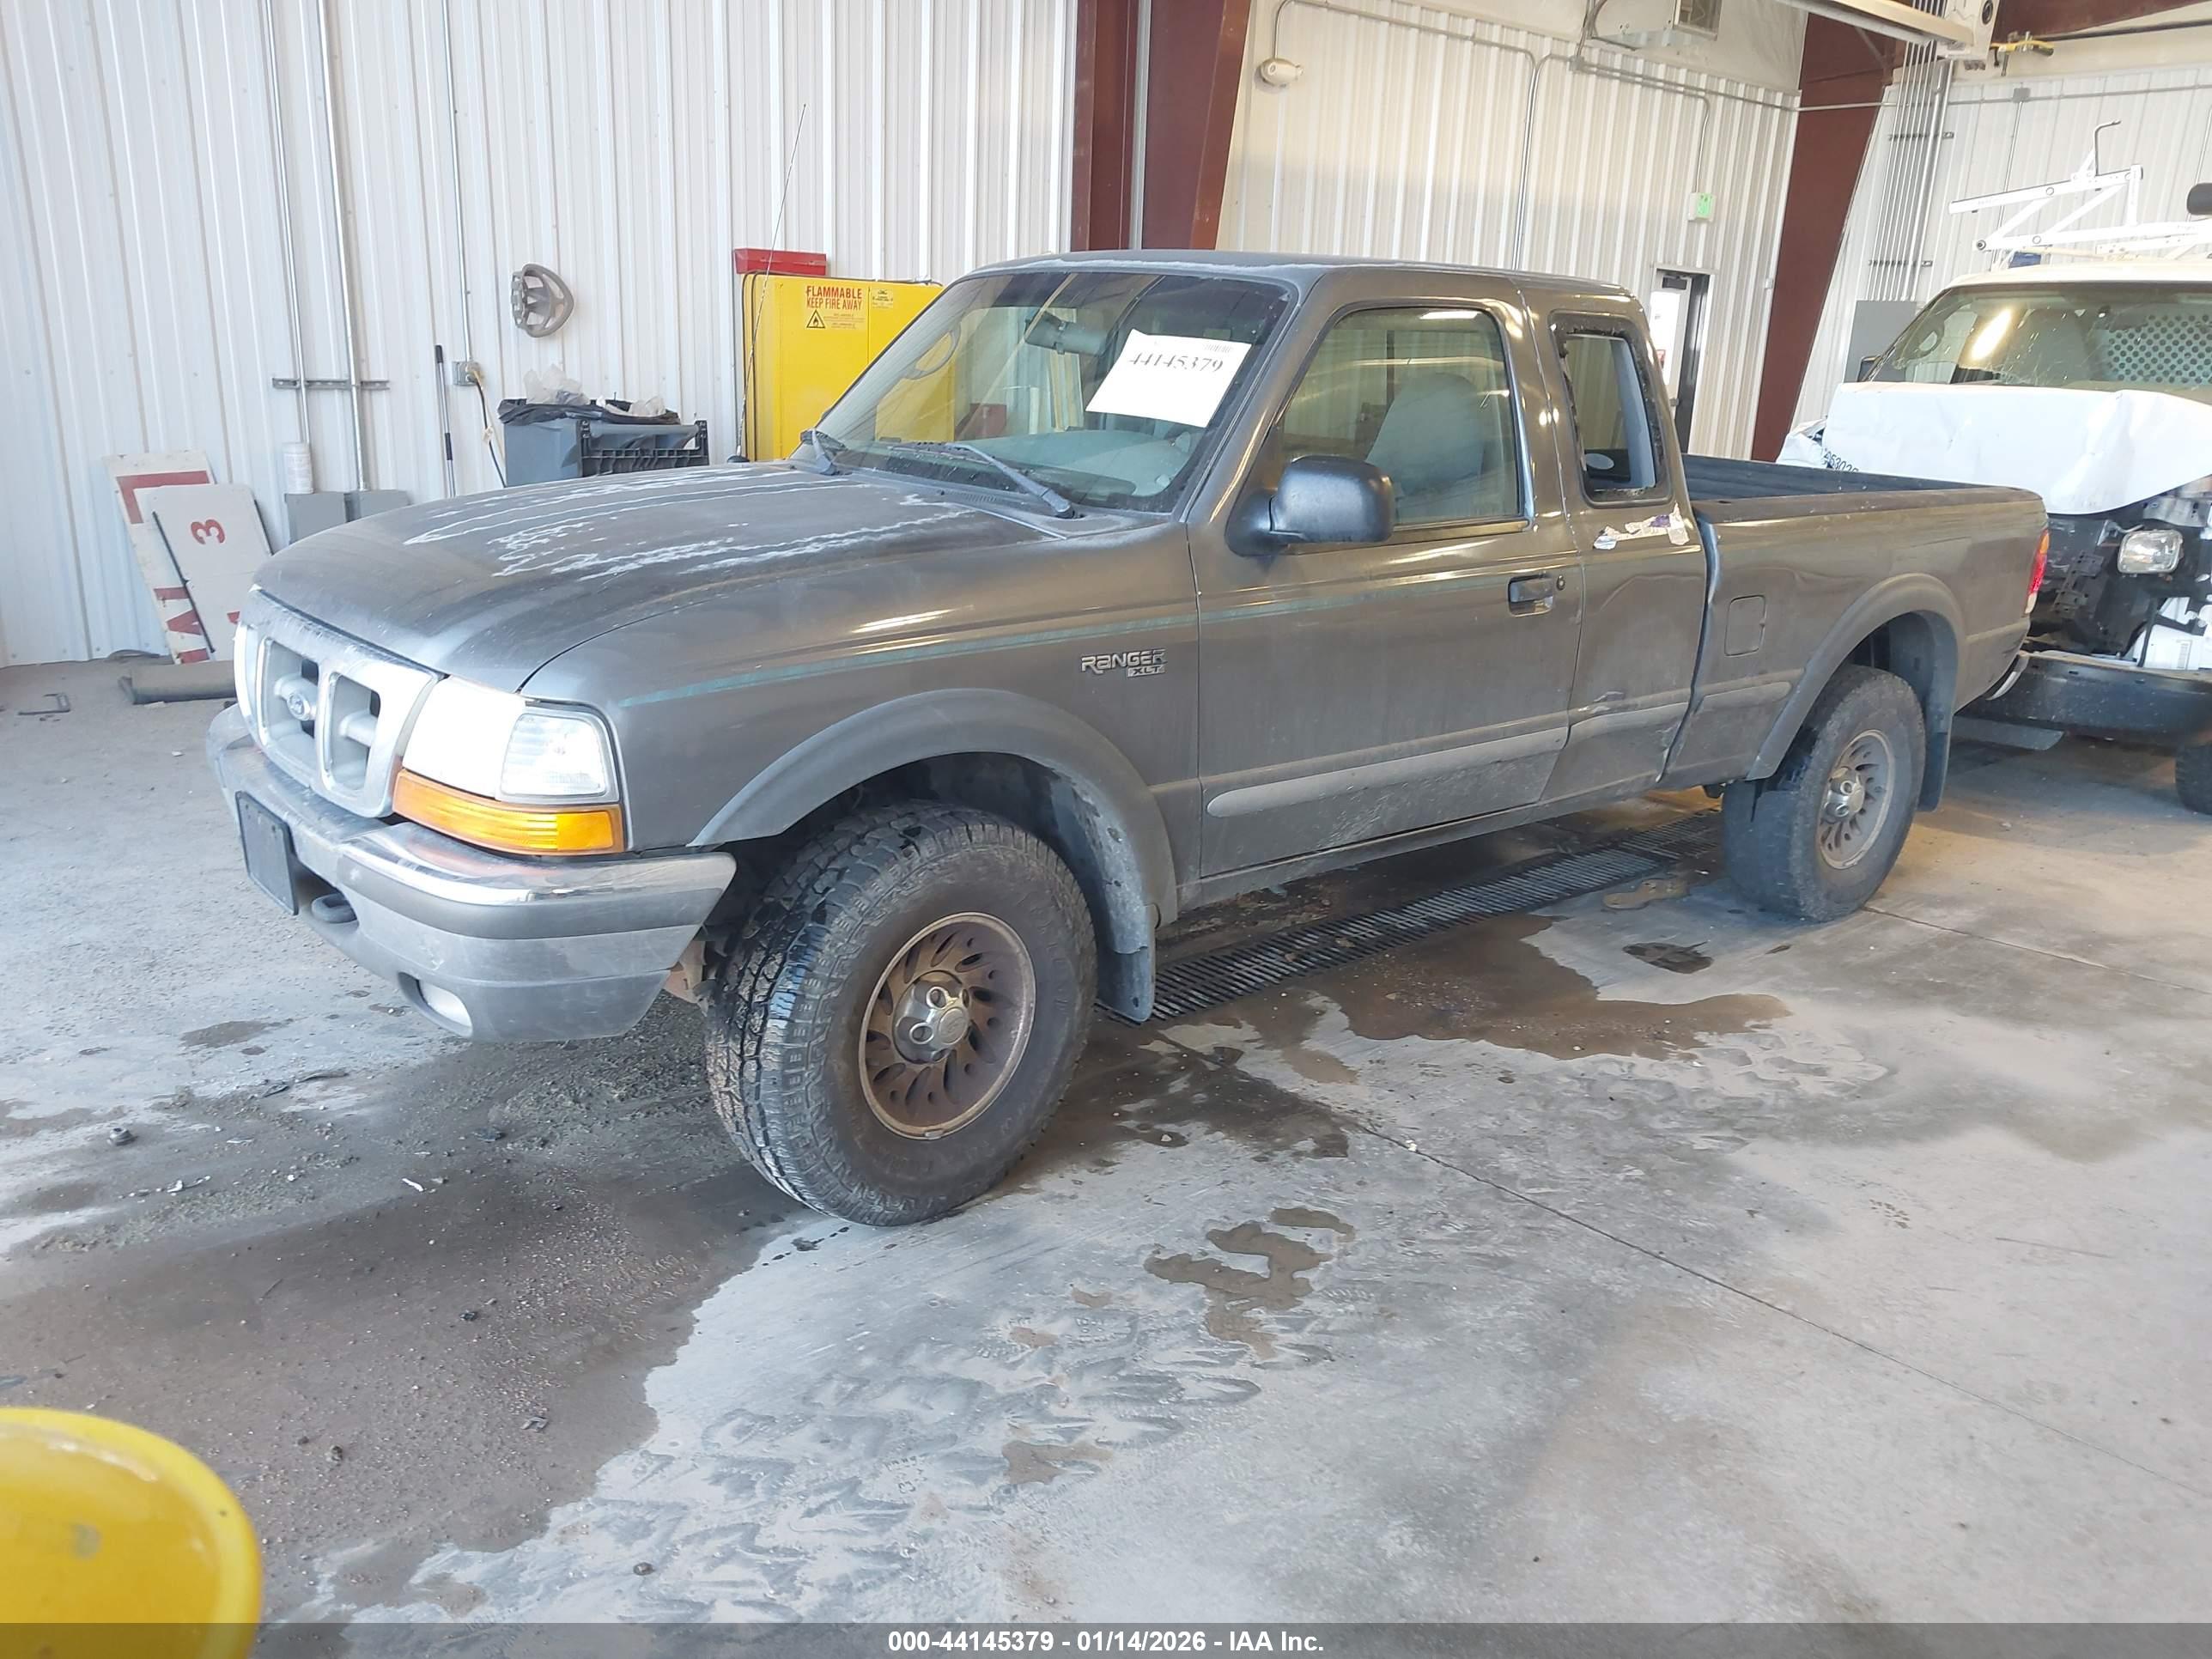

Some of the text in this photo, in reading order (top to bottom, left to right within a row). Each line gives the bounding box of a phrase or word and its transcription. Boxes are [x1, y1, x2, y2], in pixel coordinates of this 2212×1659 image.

[806, 285, 862, 299] FLAMMABLE
[806, 297, 862, 310] KEEP FIRE AWAY
[1128, 352, 1224, 373] 44145379
[191, 519, 226, 545] 3
[1081, 648, 1167, 674] RANGER
